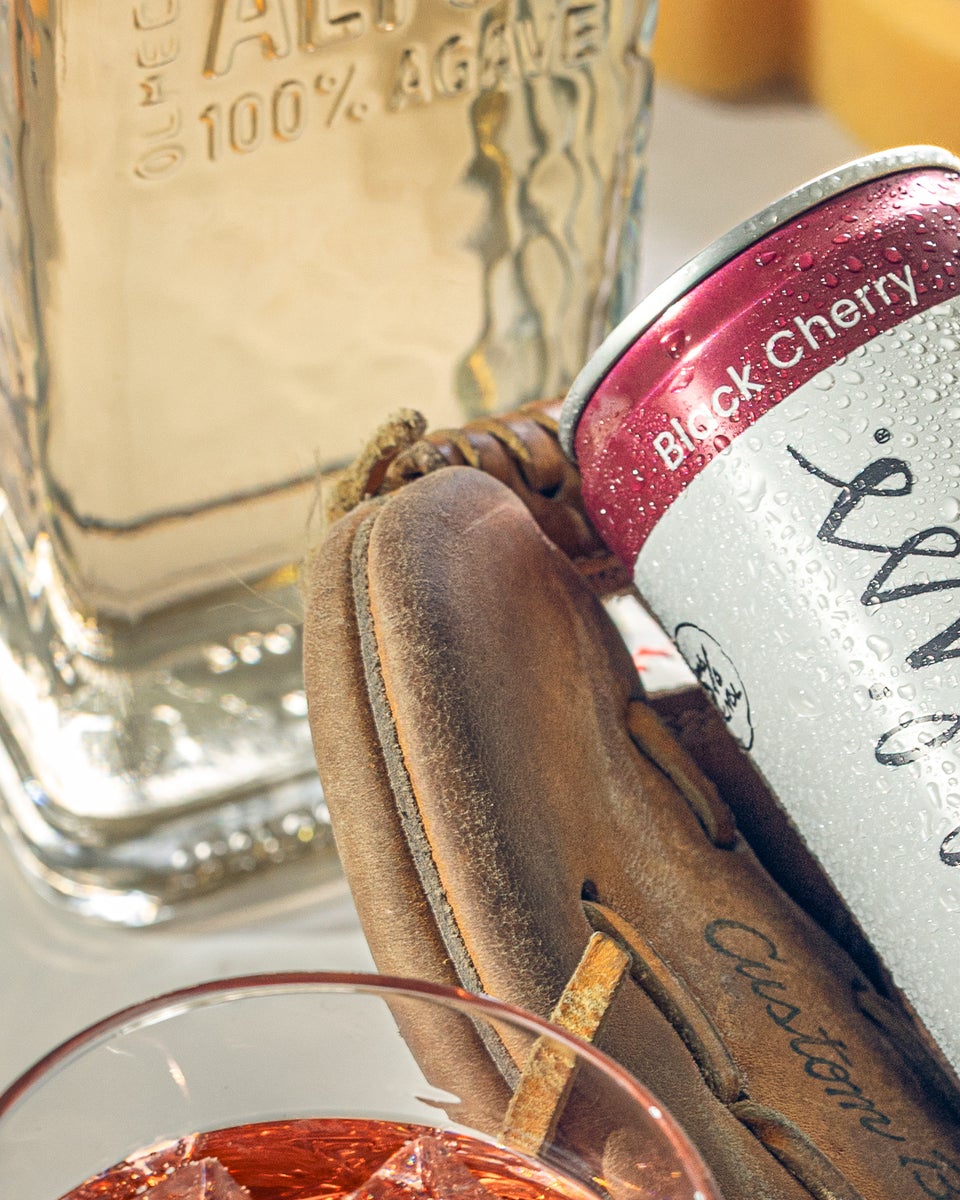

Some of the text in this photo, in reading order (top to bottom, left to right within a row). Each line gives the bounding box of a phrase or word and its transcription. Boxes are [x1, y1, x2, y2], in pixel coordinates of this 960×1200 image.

[199, 3, 602, 162] 100% AGAVE
[652, 264, 920, 473] Black Cherry
[703, 918, 905, 1143] Custom
